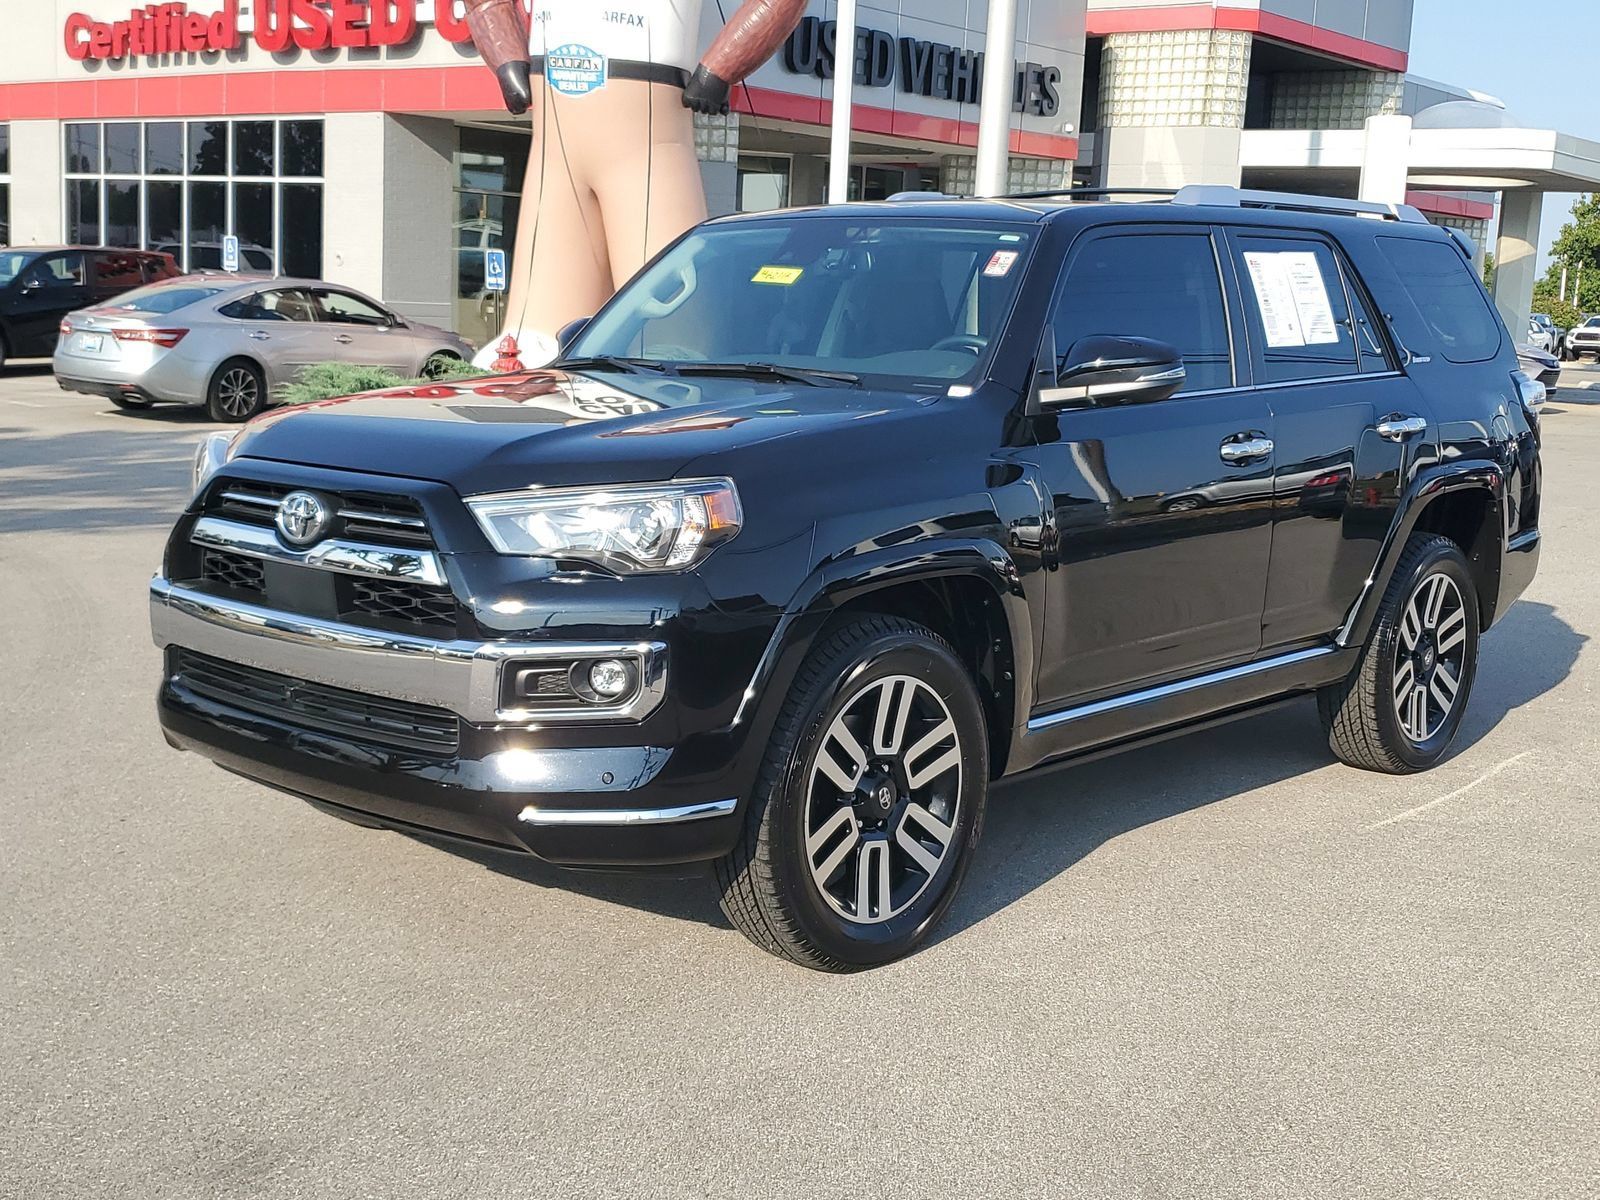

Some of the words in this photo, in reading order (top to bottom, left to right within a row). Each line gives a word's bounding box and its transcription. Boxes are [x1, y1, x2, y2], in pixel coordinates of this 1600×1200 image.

[64, 0, 239, 60] Certified
[253, 0, 417, 52] USED
[548, 56, 602, 71] CARFAX
[784, 15, 896, 88] USED
[899, 36, 1062, 117] VEHILES
